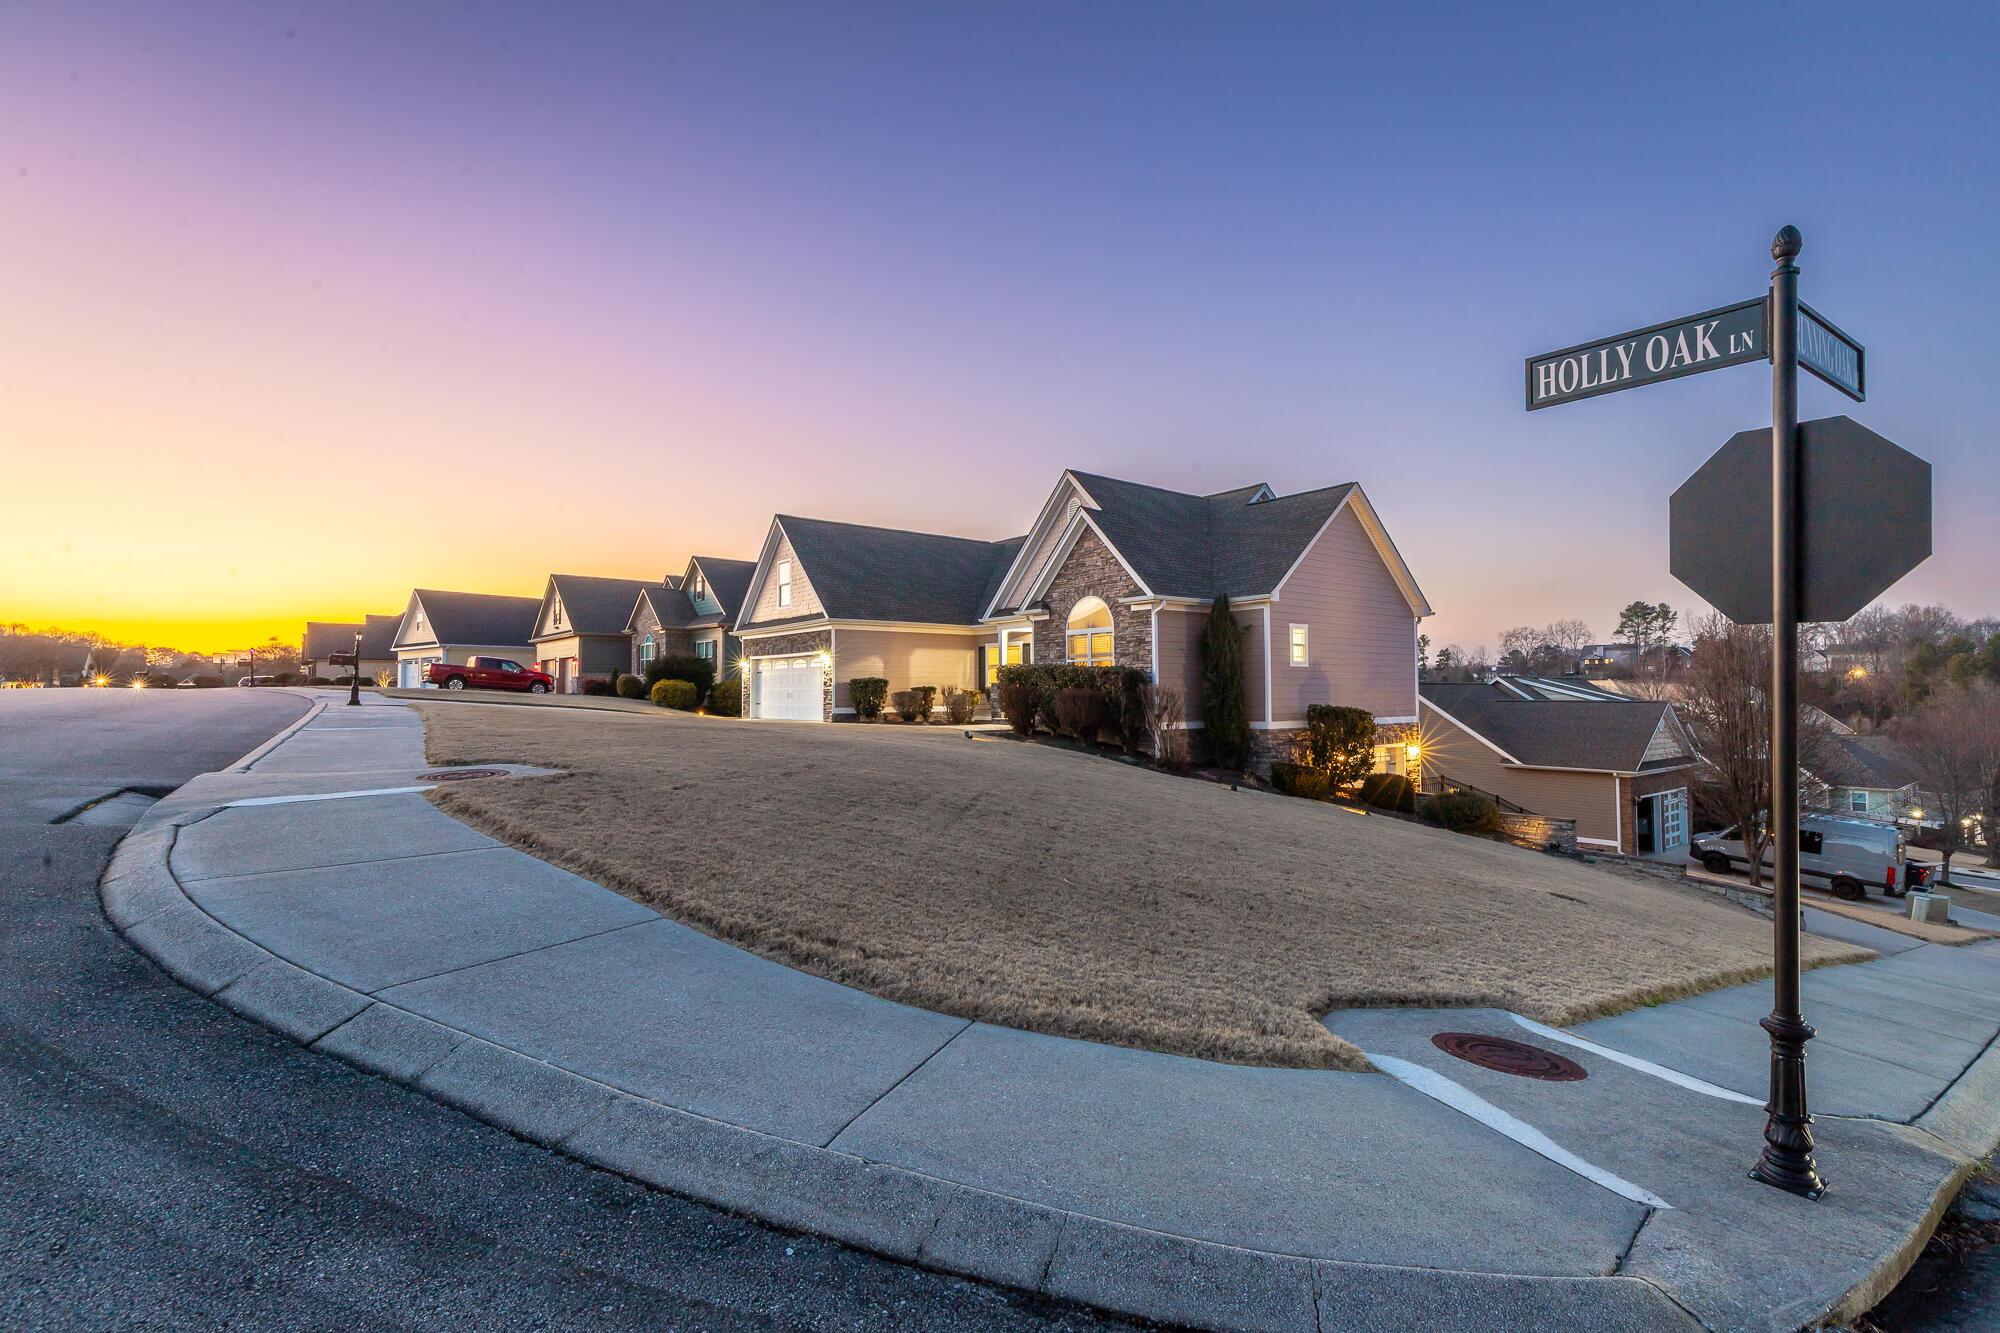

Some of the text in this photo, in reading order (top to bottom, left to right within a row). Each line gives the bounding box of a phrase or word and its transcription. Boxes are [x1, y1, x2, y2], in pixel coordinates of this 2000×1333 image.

[1537, 320, 1755, 399] HOLLY OAK LN
